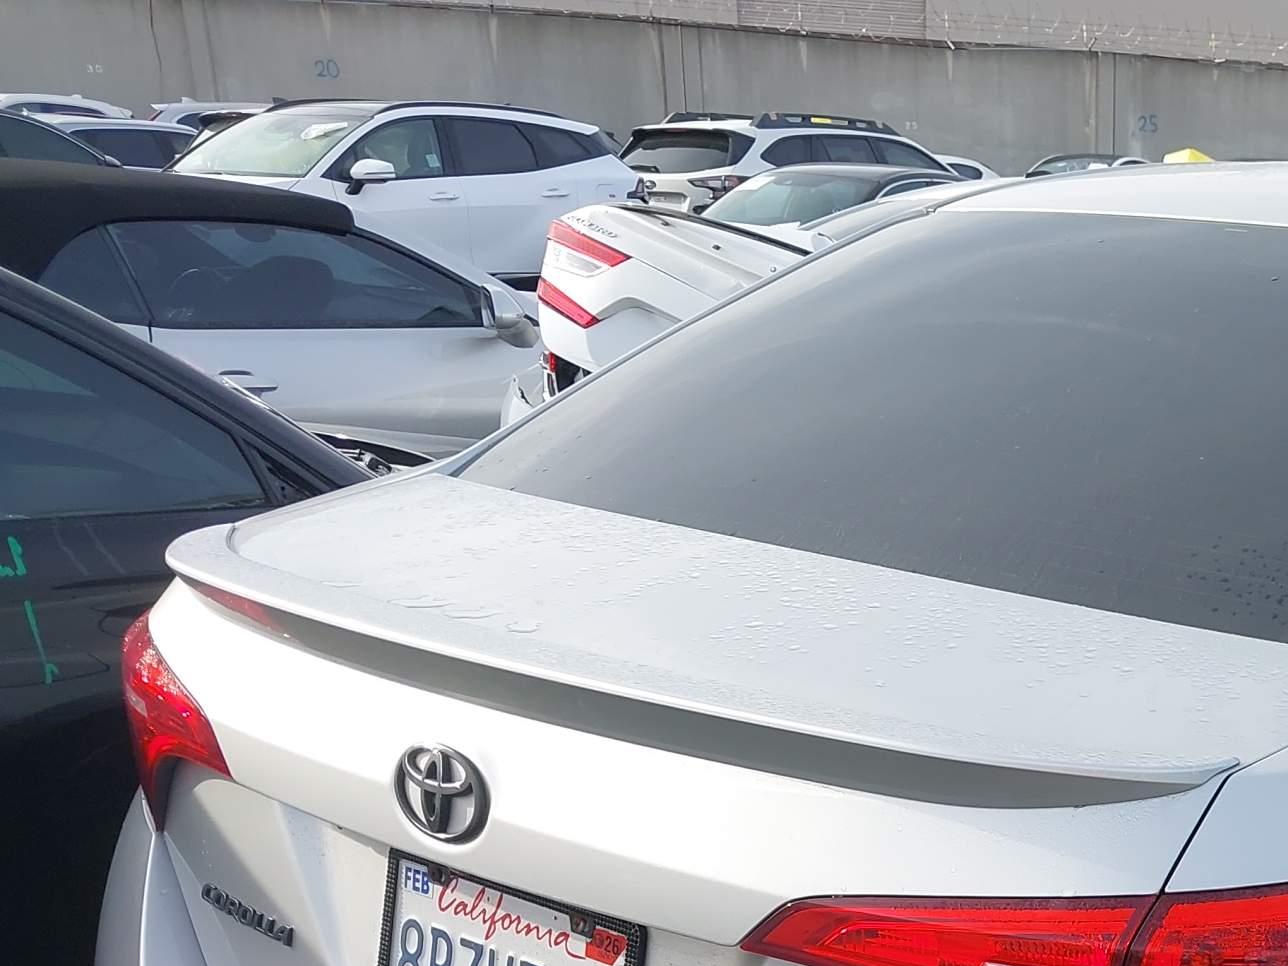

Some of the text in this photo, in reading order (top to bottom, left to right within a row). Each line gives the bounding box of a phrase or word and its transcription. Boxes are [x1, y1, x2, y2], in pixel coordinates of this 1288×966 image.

[314, 59, 340, 79] 20
[1137, 114, 1159, 134] 25
[403, 865, 431, 895] FEB
[201, 883, 295, 948] COROLLA
[437, 874, 586, 961] California
